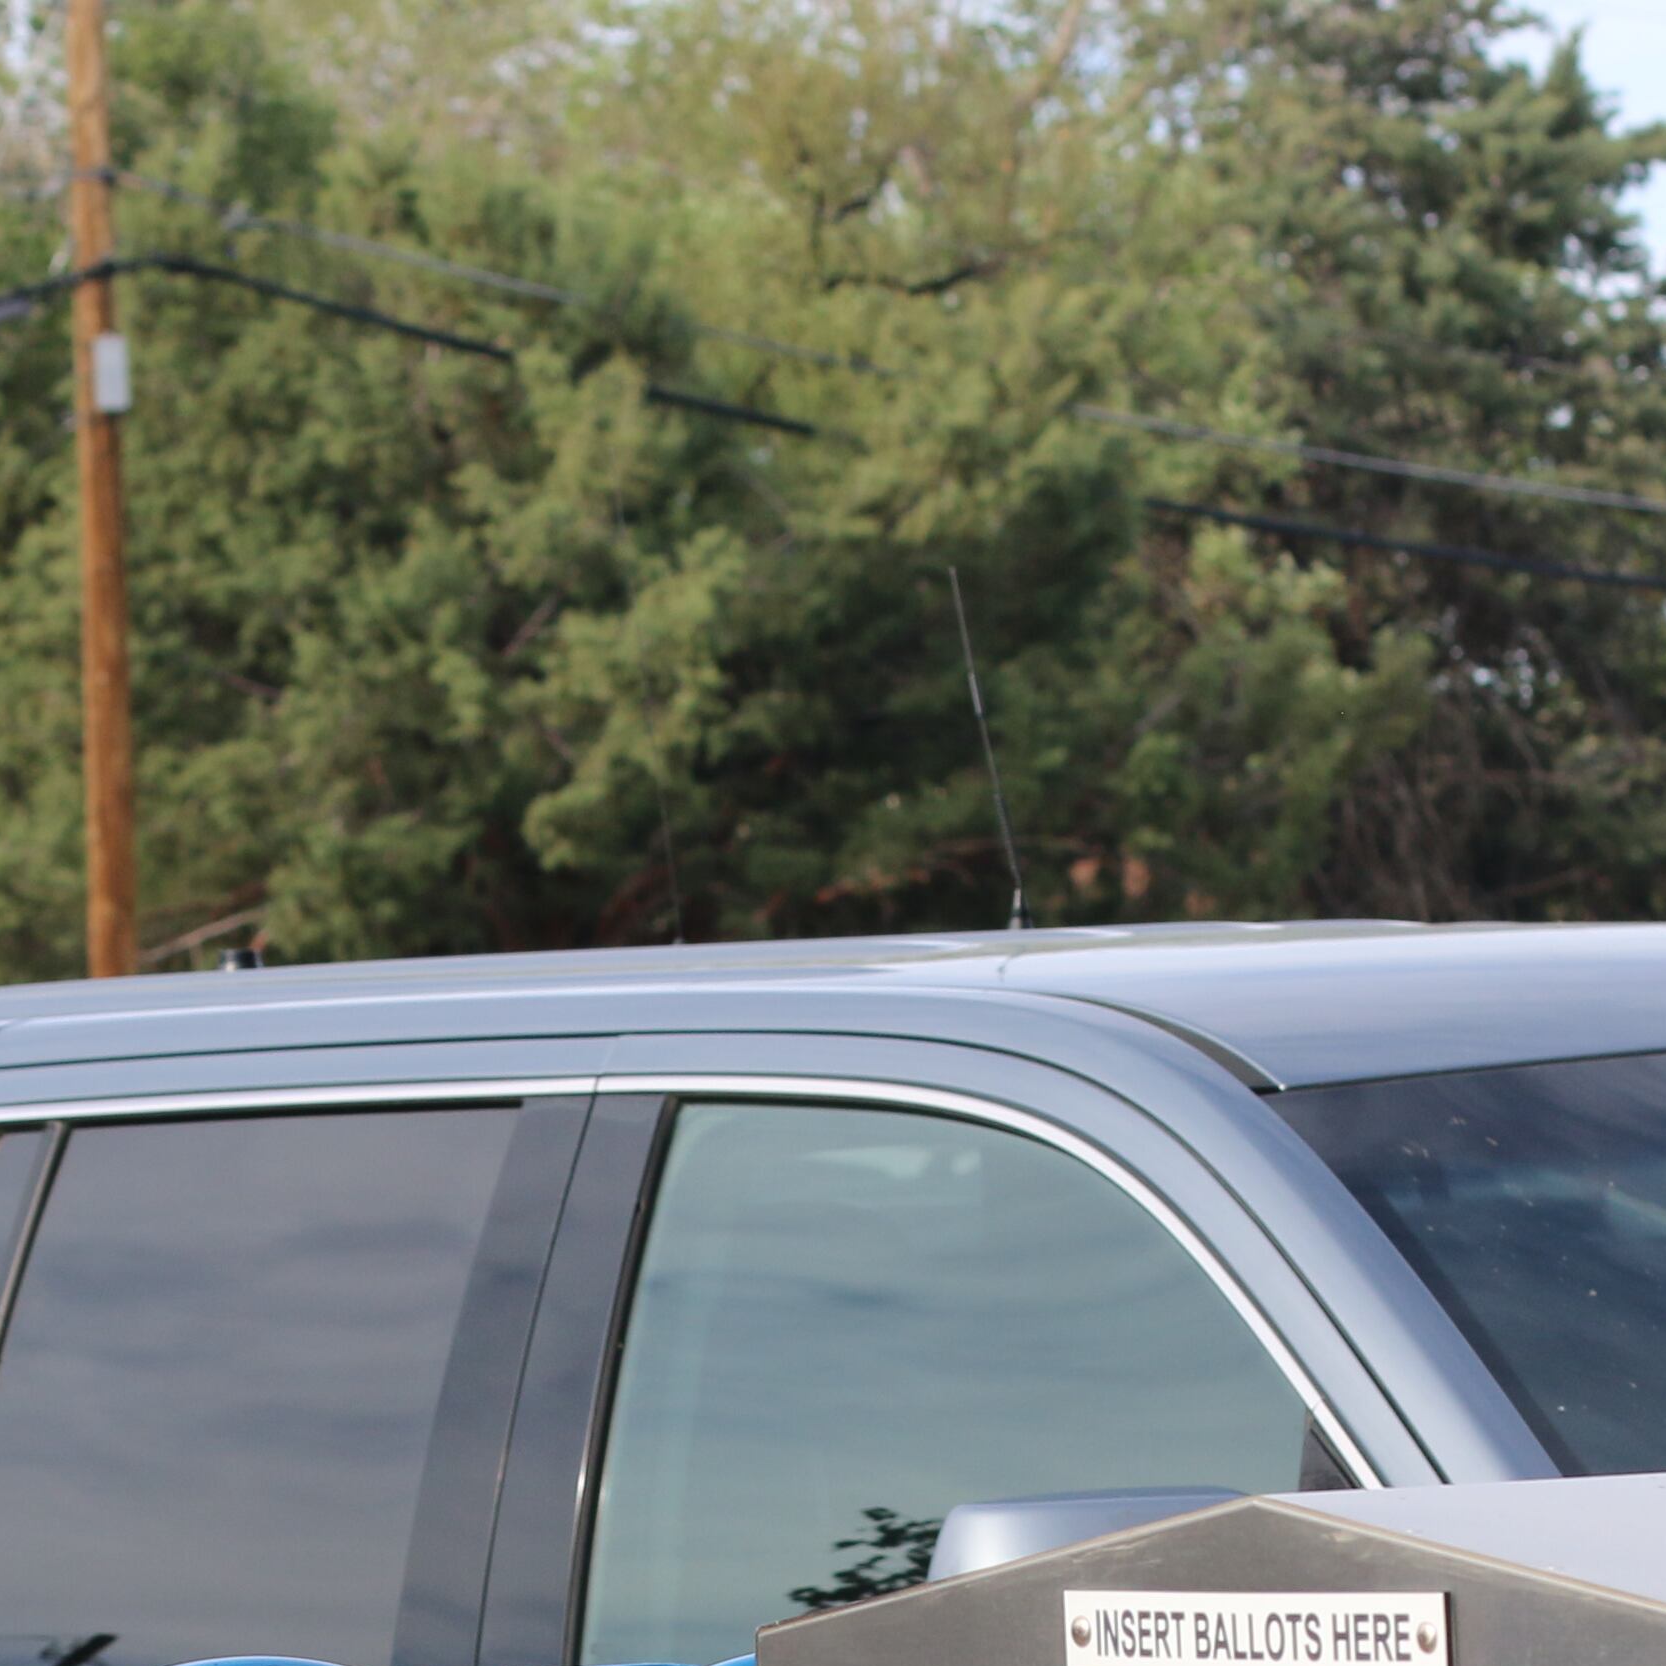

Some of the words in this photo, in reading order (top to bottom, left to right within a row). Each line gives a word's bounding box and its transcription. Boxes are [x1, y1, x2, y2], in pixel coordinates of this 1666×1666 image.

[1095, 1609, 1184, 1658] INSERT
[1195, 1612, 1322, 1661] BALLOTS
[1331, 1613, 1413, 1661] HERE
